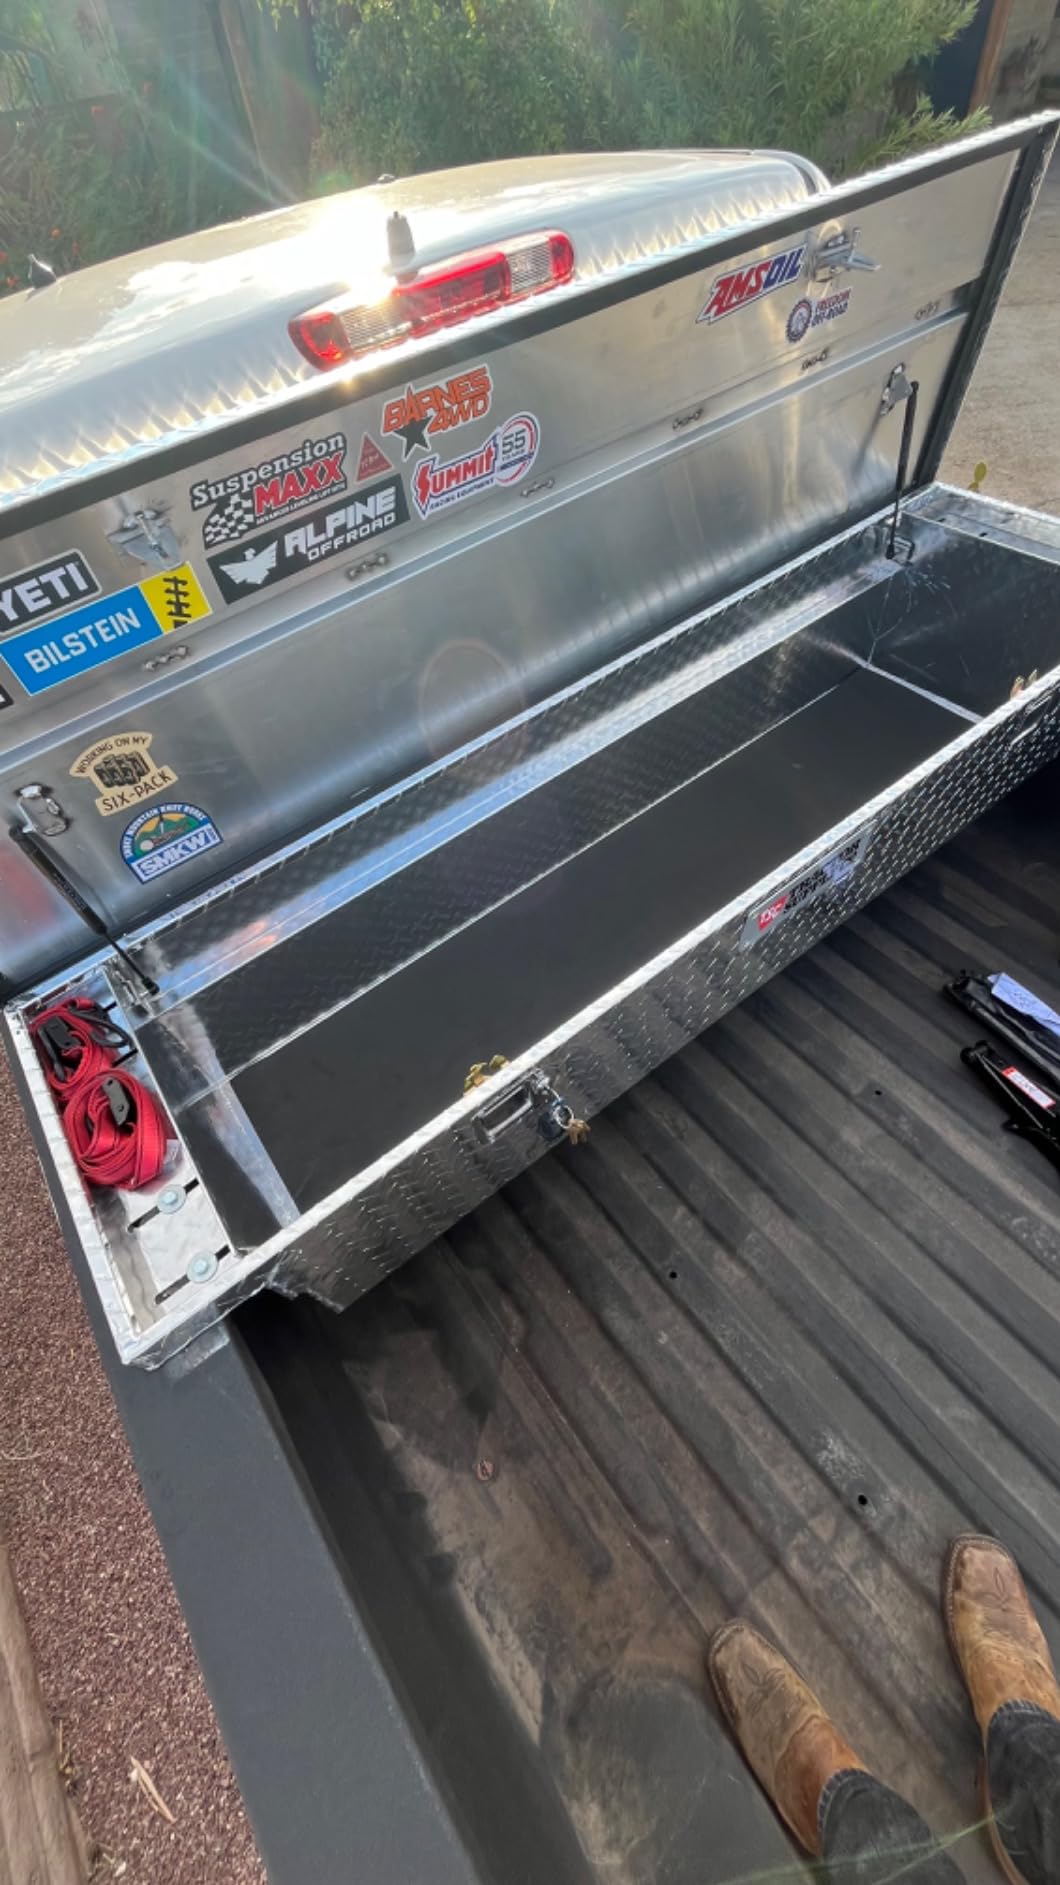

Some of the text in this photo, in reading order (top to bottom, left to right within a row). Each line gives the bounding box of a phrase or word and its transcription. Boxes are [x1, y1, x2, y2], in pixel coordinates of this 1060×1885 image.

[704, 249, 803, 317] AMSOIL
[383, 366, 491, 433] BARNES
[427, 393, 489, 433] 4WD
[502, 428, 526, 454] 55
[192, 435, 344, 507] Suspension
[255, 452, 343, 515] MAXX
[284, 486, 396, 557] ALPINE
[307, 512, 396, 561] OFFROAD
[0, 563, 89, 622] YETI
[24, 608, 141, 673] BILSTEIN
[75, 736, 149, 774] WORKING ON MY
[102, 770, 172, 811] SIX-PACK
[139, 830, 206, 876] SMKW
